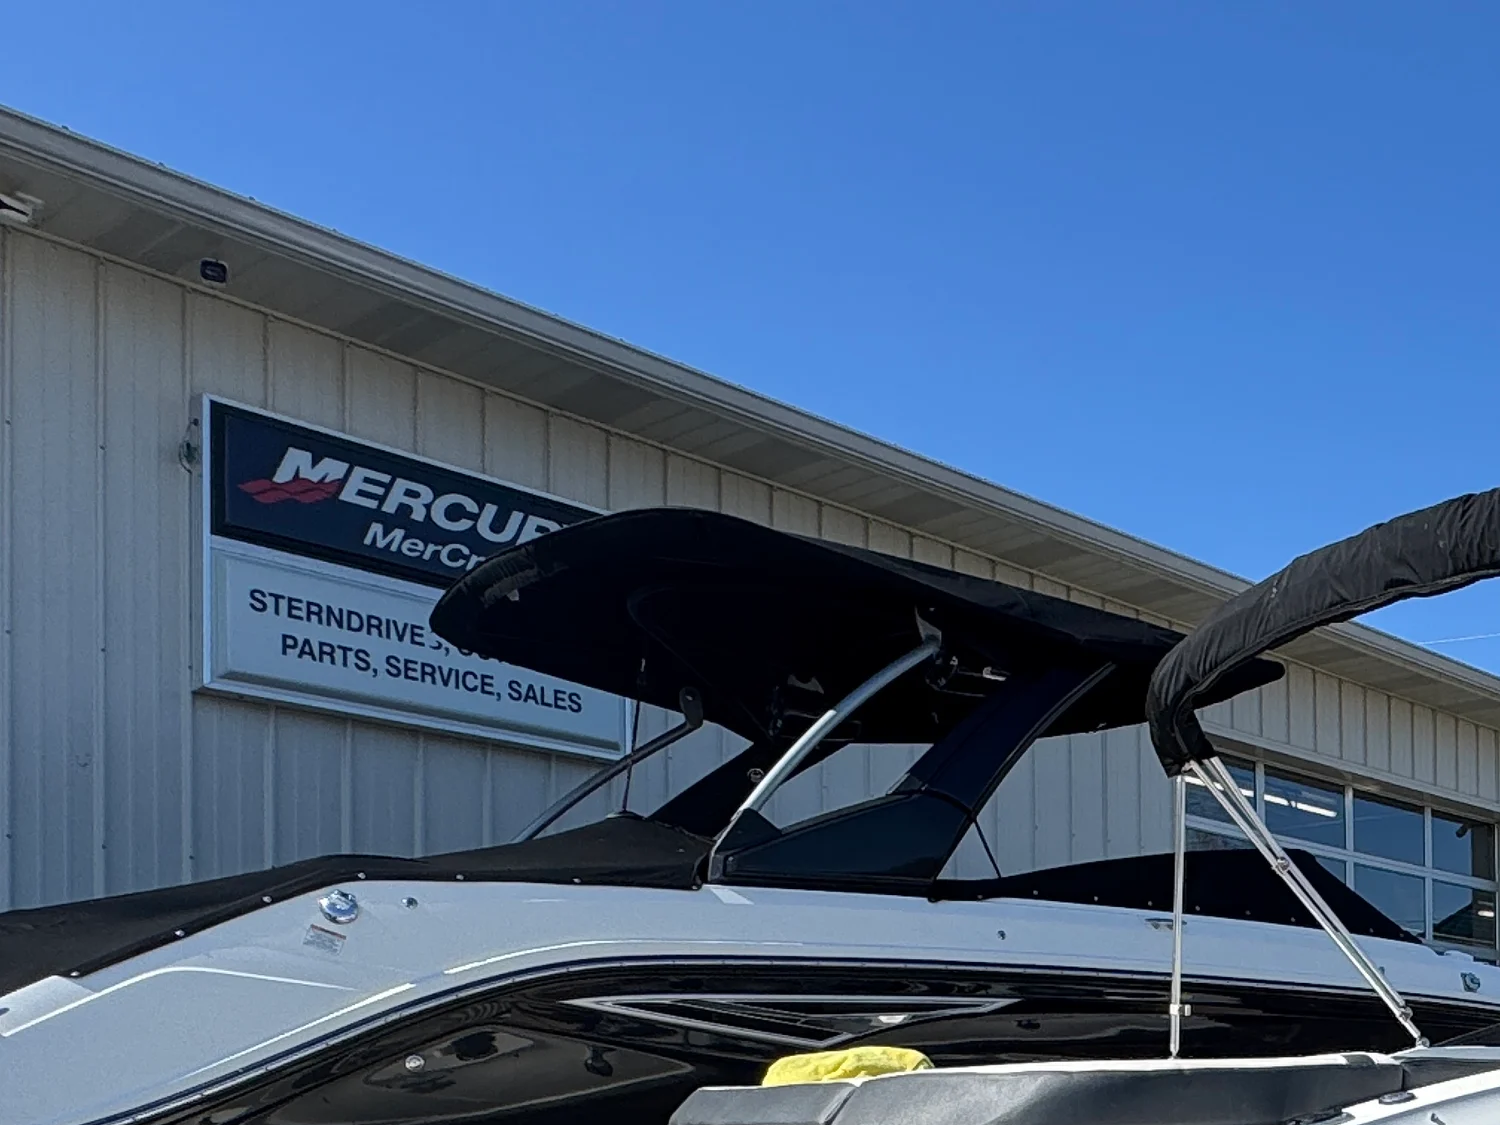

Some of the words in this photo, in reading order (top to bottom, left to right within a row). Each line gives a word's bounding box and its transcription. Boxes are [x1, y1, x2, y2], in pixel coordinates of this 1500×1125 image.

[272, 446, 571, 546] MERCUR
[363, 522, 487, 571] MerCr
[281, 634, 379, 679] PARTS,
[385, 655, 502, 701] SERVICE,
[507, 680, 583, 713] SALES
